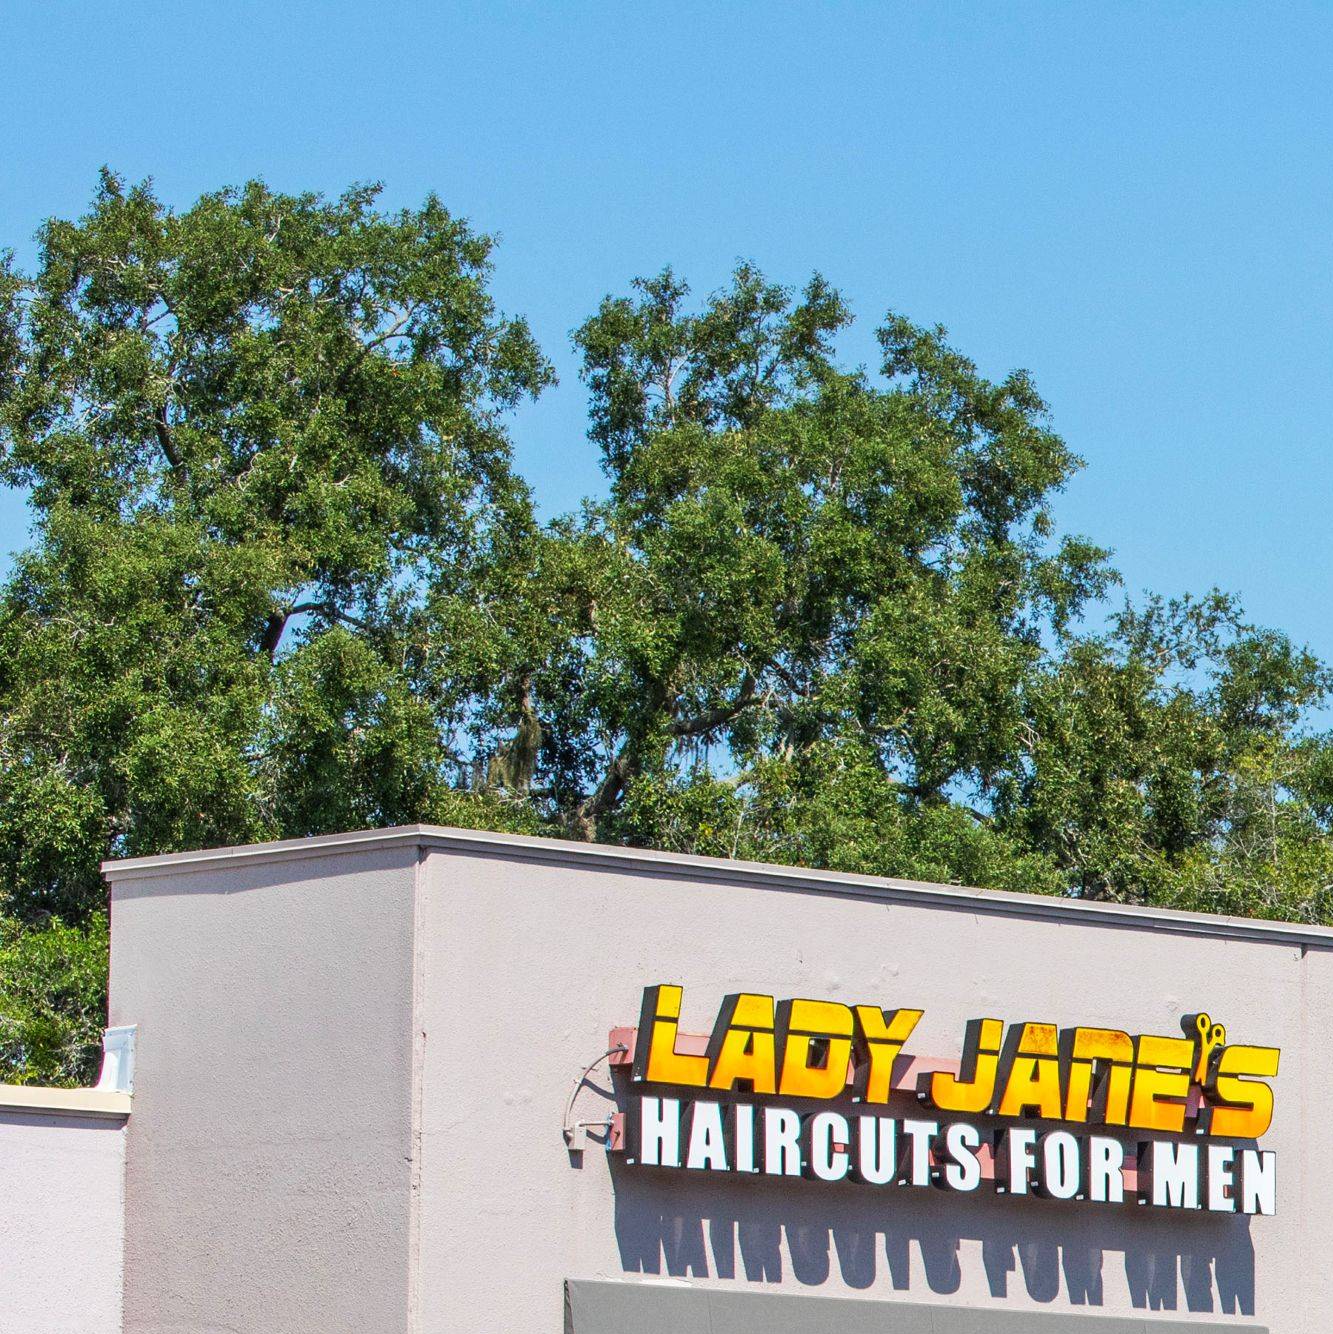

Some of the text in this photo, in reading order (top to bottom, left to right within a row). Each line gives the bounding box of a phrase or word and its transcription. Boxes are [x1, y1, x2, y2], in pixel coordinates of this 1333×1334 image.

[635, 984, 925, 1105] LADY
[634, 1095, 1277, 1217] HAIRCUTS FOR MEN
